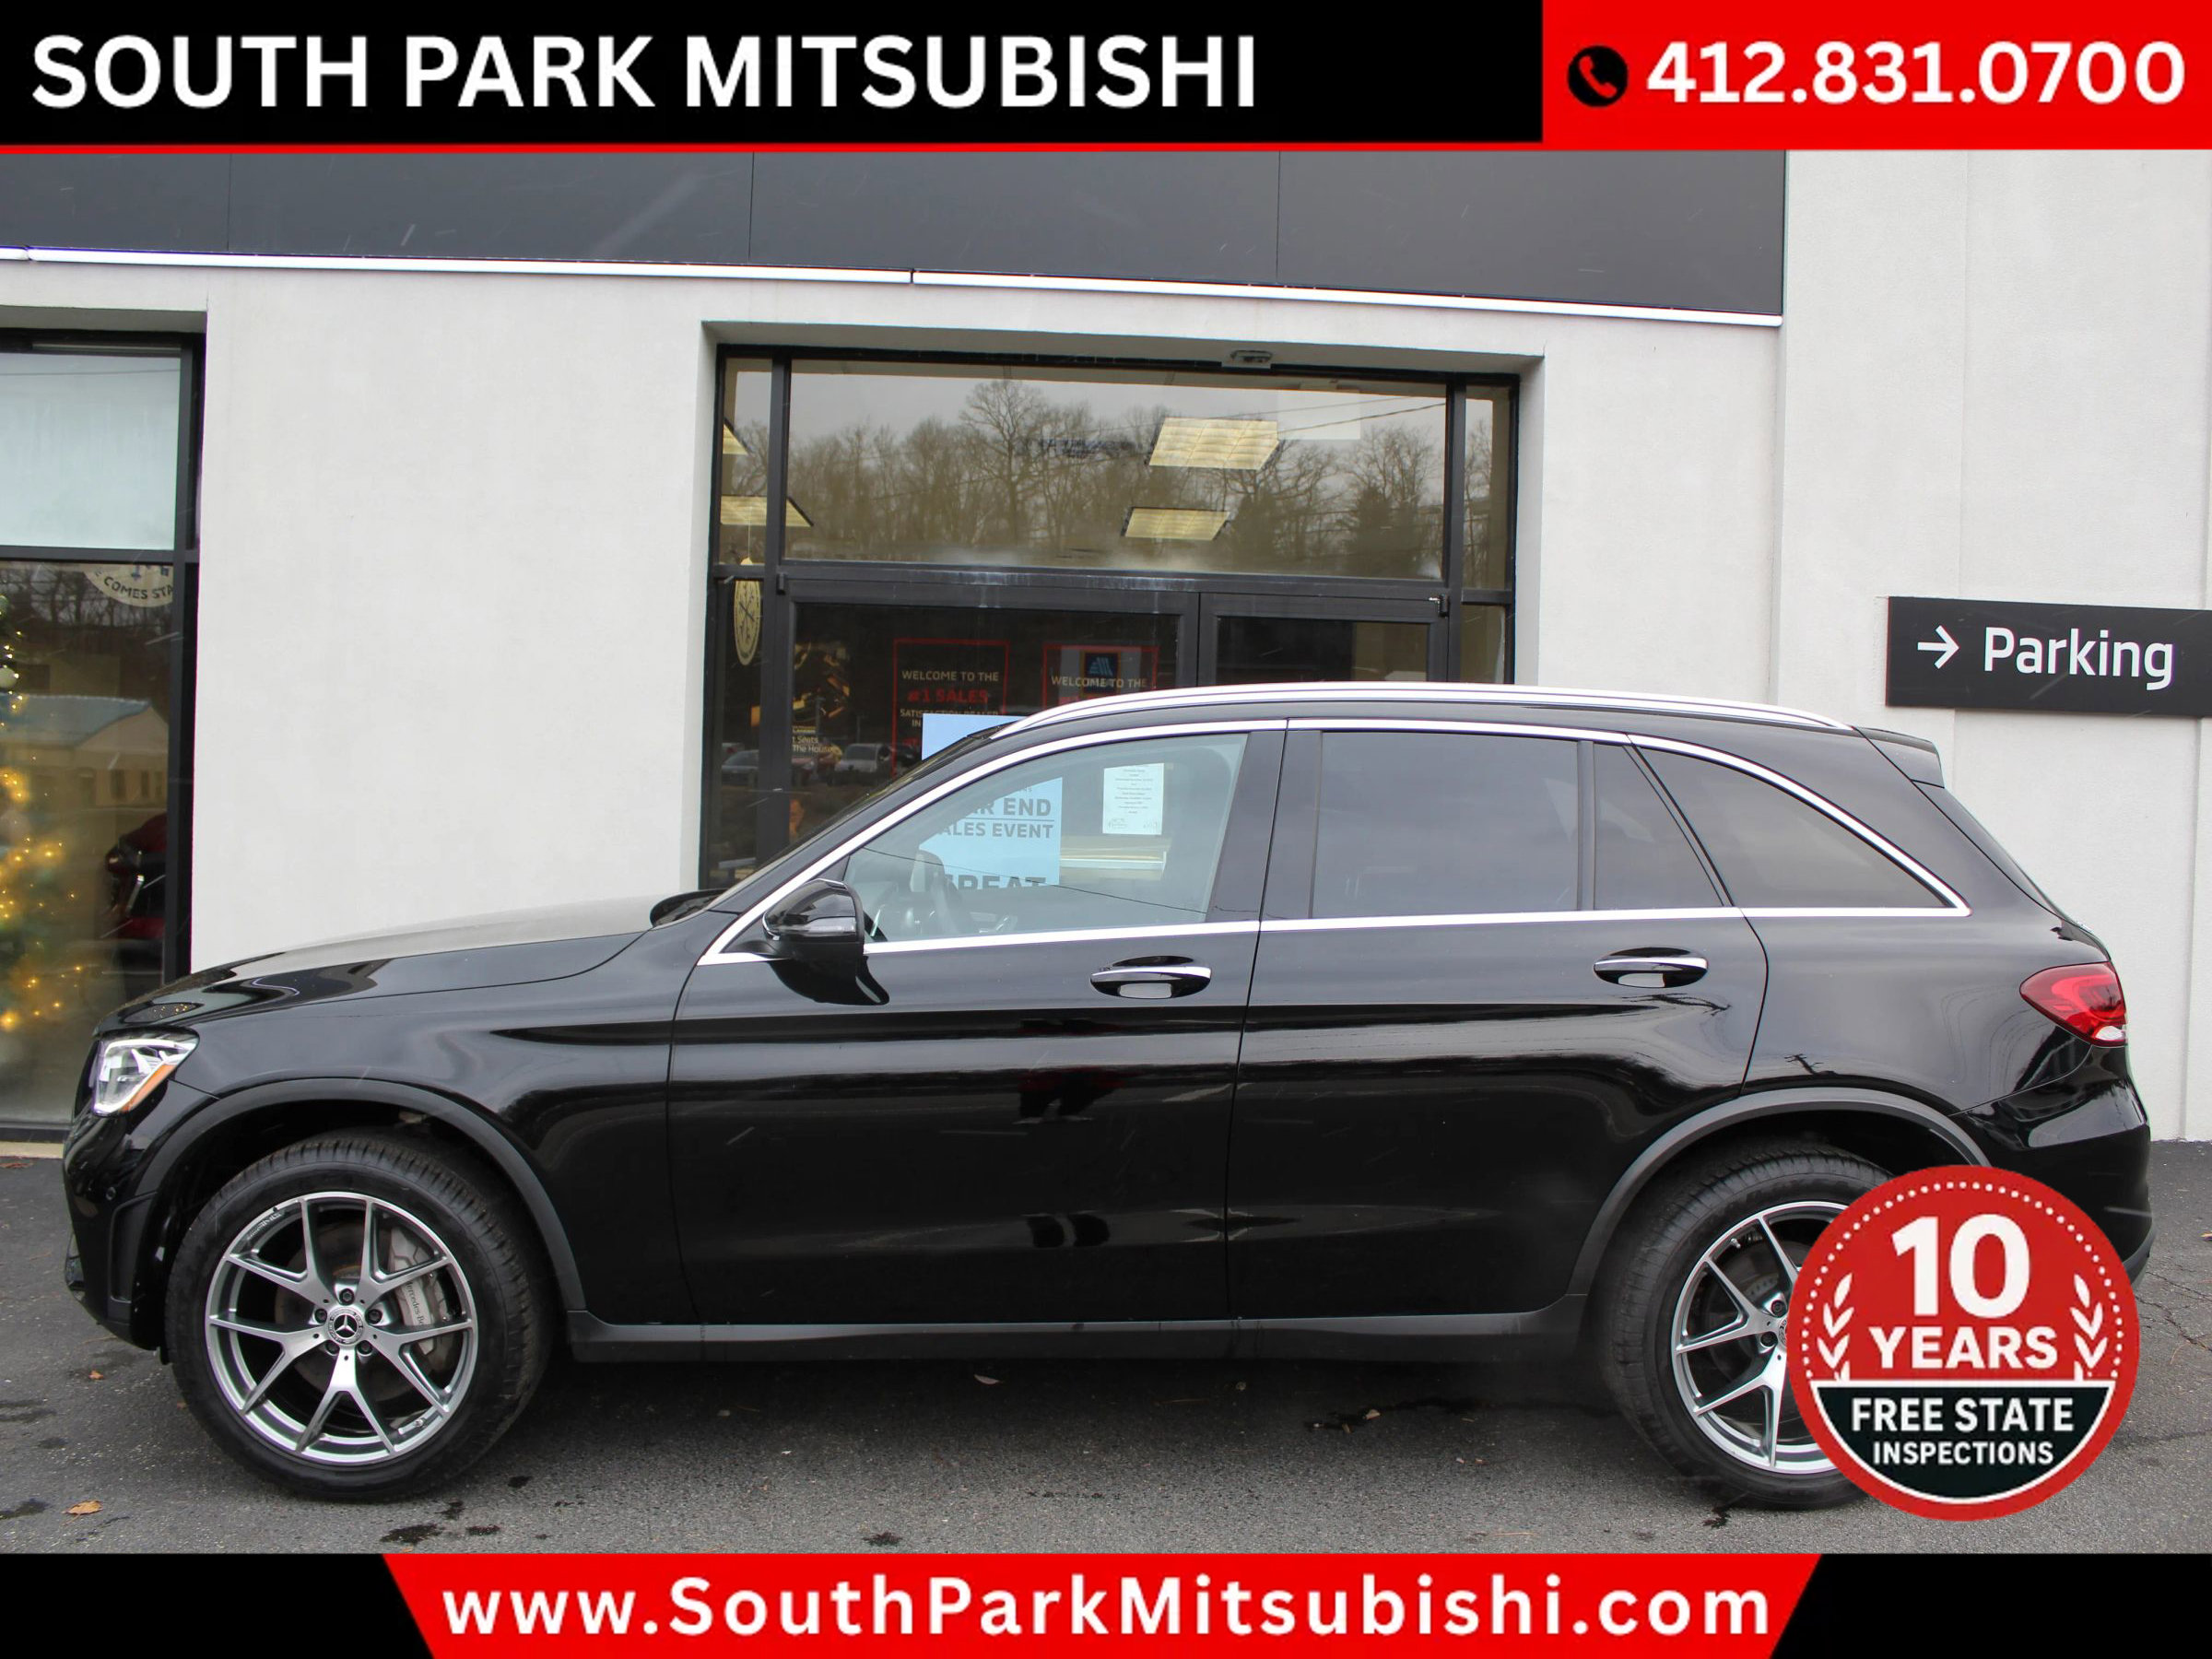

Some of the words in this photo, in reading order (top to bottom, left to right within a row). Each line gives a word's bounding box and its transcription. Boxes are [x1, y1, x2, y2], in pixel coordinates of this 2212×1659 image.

[103, 576, 148, 600] COMES
[151, 584, 174, 599] STA
[1984, 627, 2173, 690] Parking
[901, 670, 957, 681] WELCOME
[961, 671, 975, 681] TO
[978, 672, 999, 682] THE
[1051, 676, 1106, 688] WELCOME
[1108, 677, 1124, 688] TO
[1127, 678, 1148, 688] THE
[935, 688, 988, 704] SALES
[1003, 797, 1052, 818] END
[938, 821, 986, 837] ALES
[992, 822, 1053, 839] EVENT
